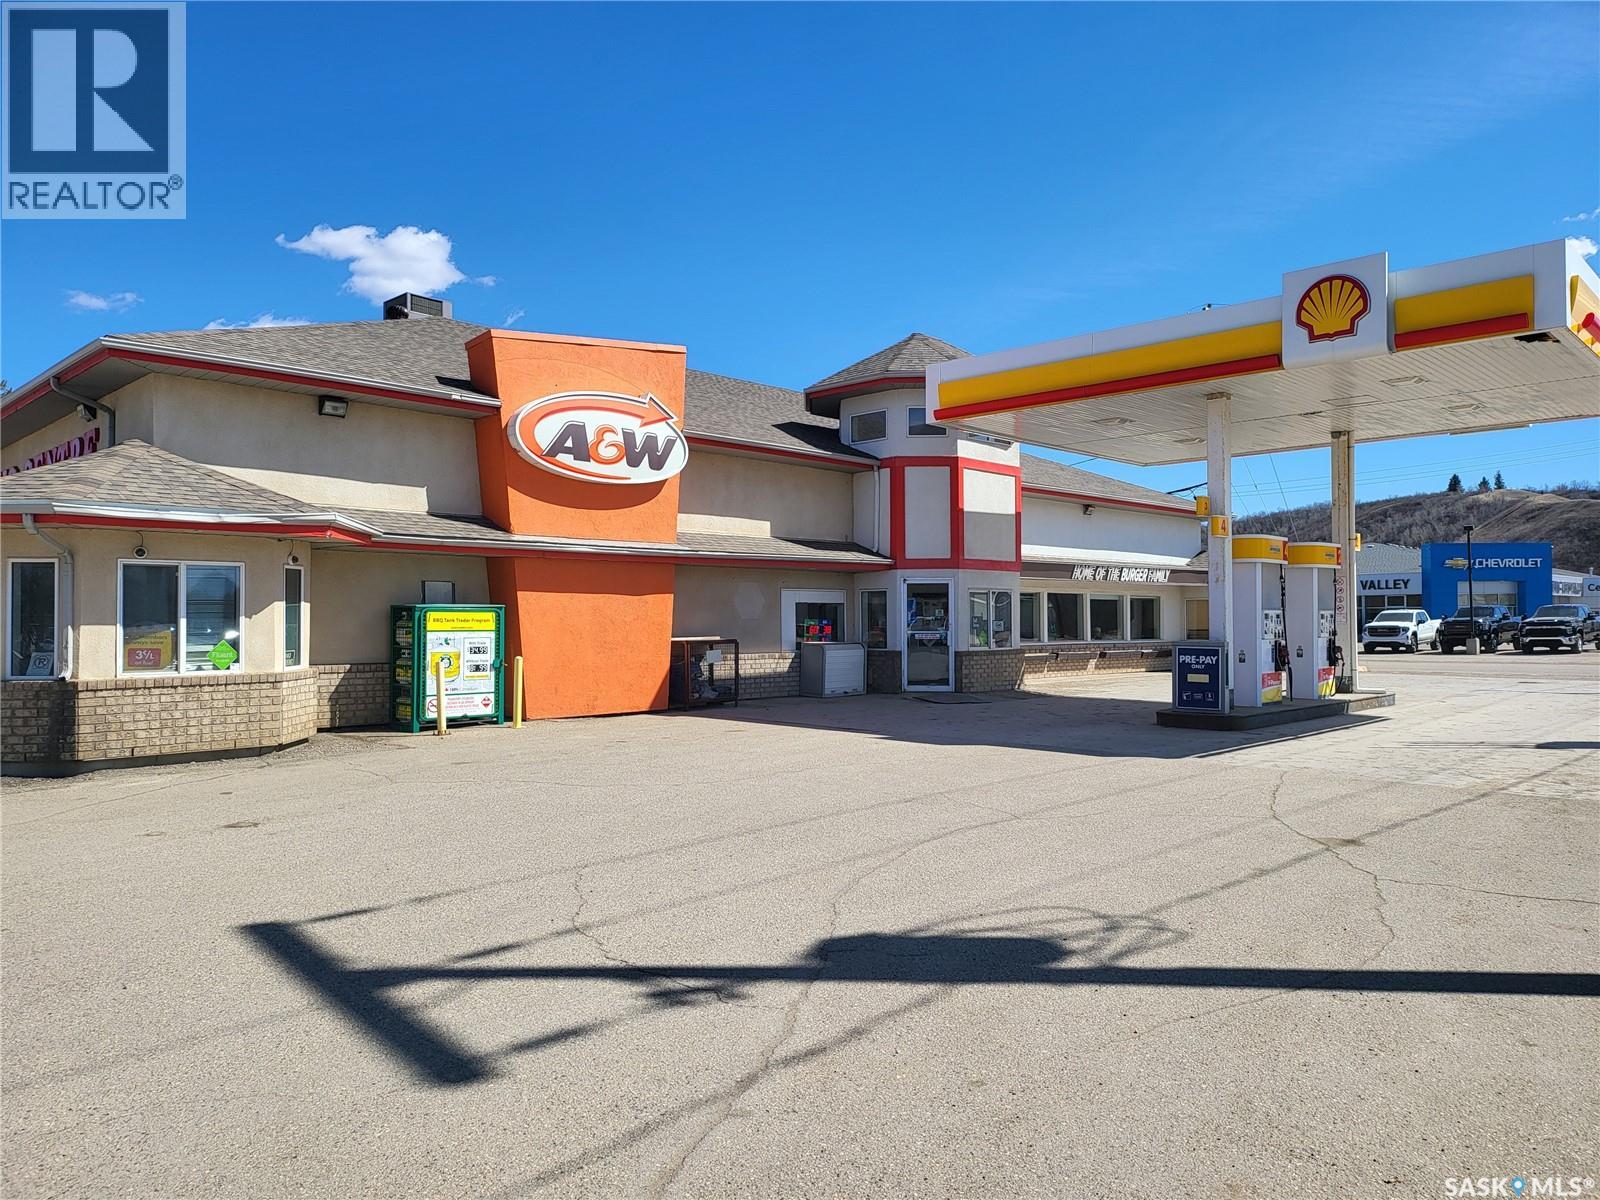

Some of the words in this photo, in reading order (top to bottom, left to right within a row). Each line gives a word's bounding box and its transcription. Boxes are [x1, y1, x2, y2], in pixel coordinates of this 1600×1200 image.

[541, 420, 678, 472] A&W
[1220, 519, 1227, 533] 4
[1476, 558, 1543, 568] CHEVROLET
[1072, 565, 1096, 580] HOME
[1095, 566, 1107, 580] OF
[1106, 567, 1120, 581] THE
[1121, 568, 1148, 582] BURGER
[1148, 568, 1171, 583] FAMILY
[1360, 579, 1410, 590] VALLEY
[1179, 655, 1217, 664] PRE-PAY
